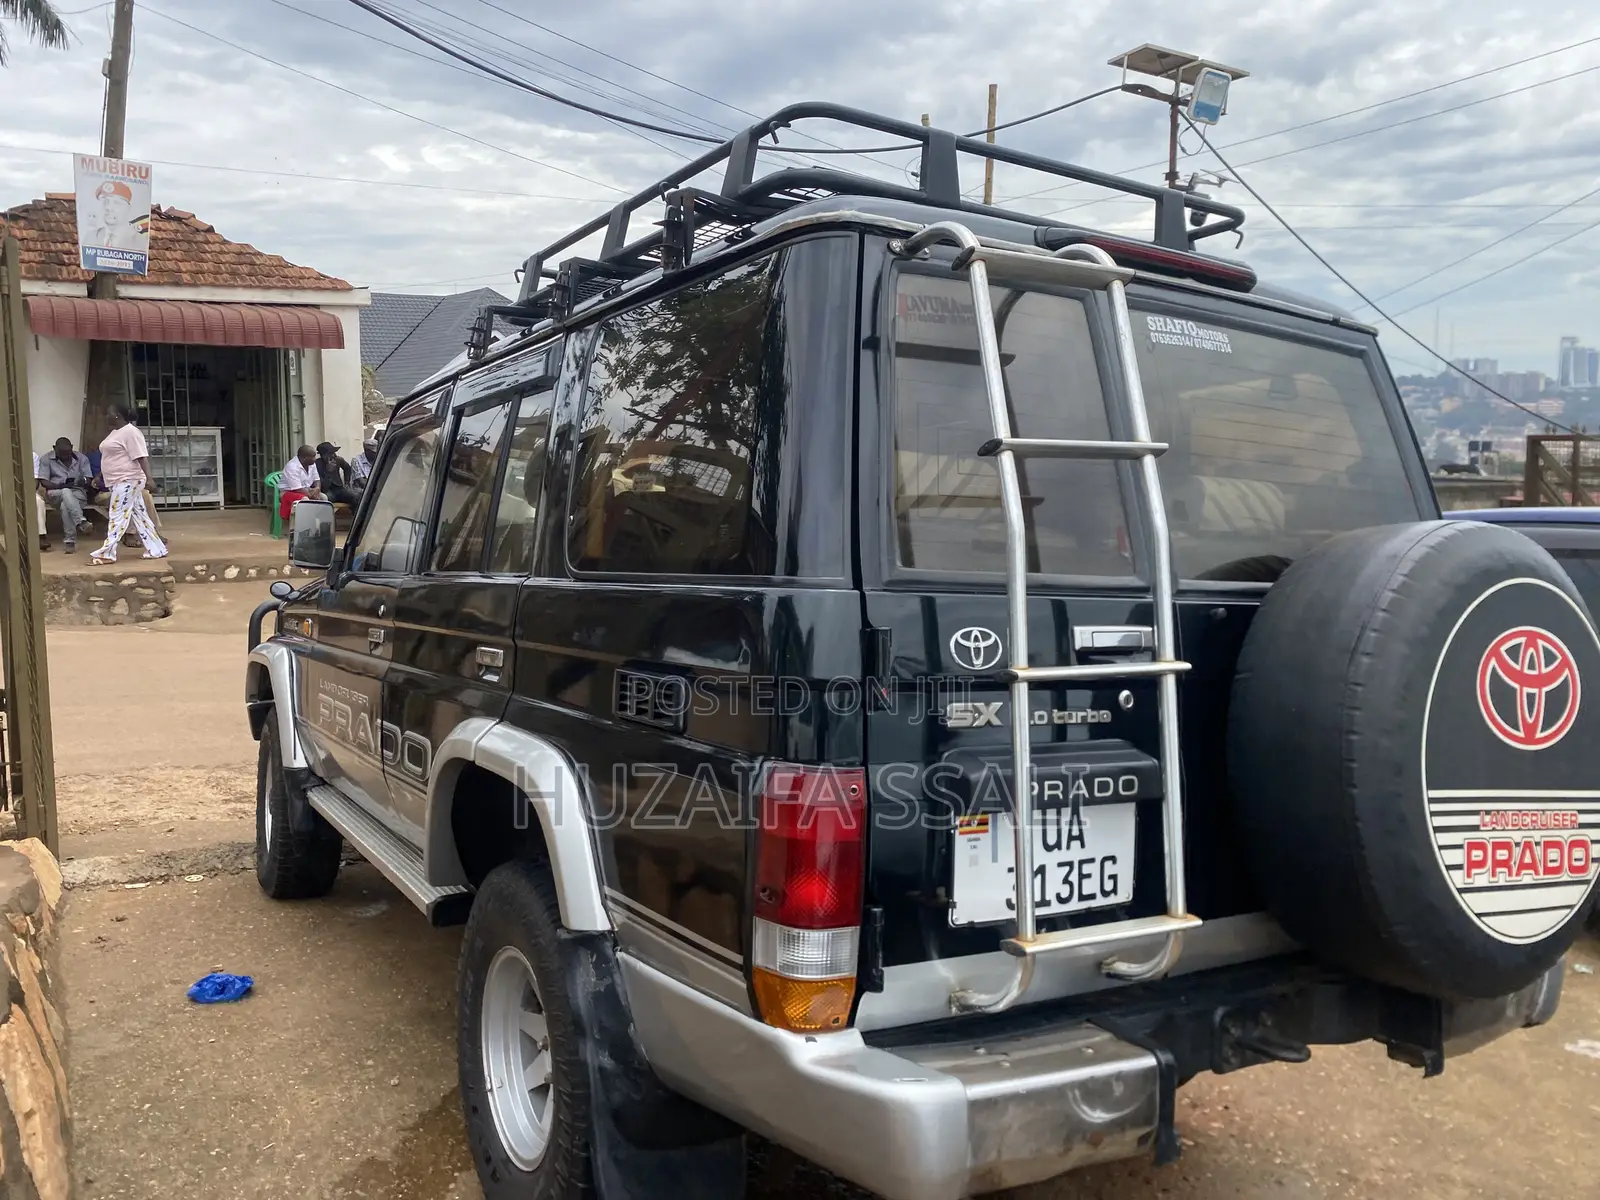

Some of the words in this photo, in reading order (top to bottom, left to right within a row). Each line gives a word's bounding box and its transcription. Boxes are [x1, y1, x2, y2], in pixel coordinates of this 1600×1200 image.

[80, 157, 150, 180] MUBIRU
[85, 247, 97, 256] MP
[97, 249, 123, 260] RUBAGA
[123, 252, 145, 262] NORTH
[1197, 328, 1229, 343] MOTORS
[947, 701, 1004, 728] SX
[1052, 708, 1112, 724] turbo
[317, 692, 432, 782] PRADO
[1041, 806, 1087, 853] UA
[1480, 810, 1580, 830] LANDCRUISER
[1463, 834, 1593, 884] PRADO
